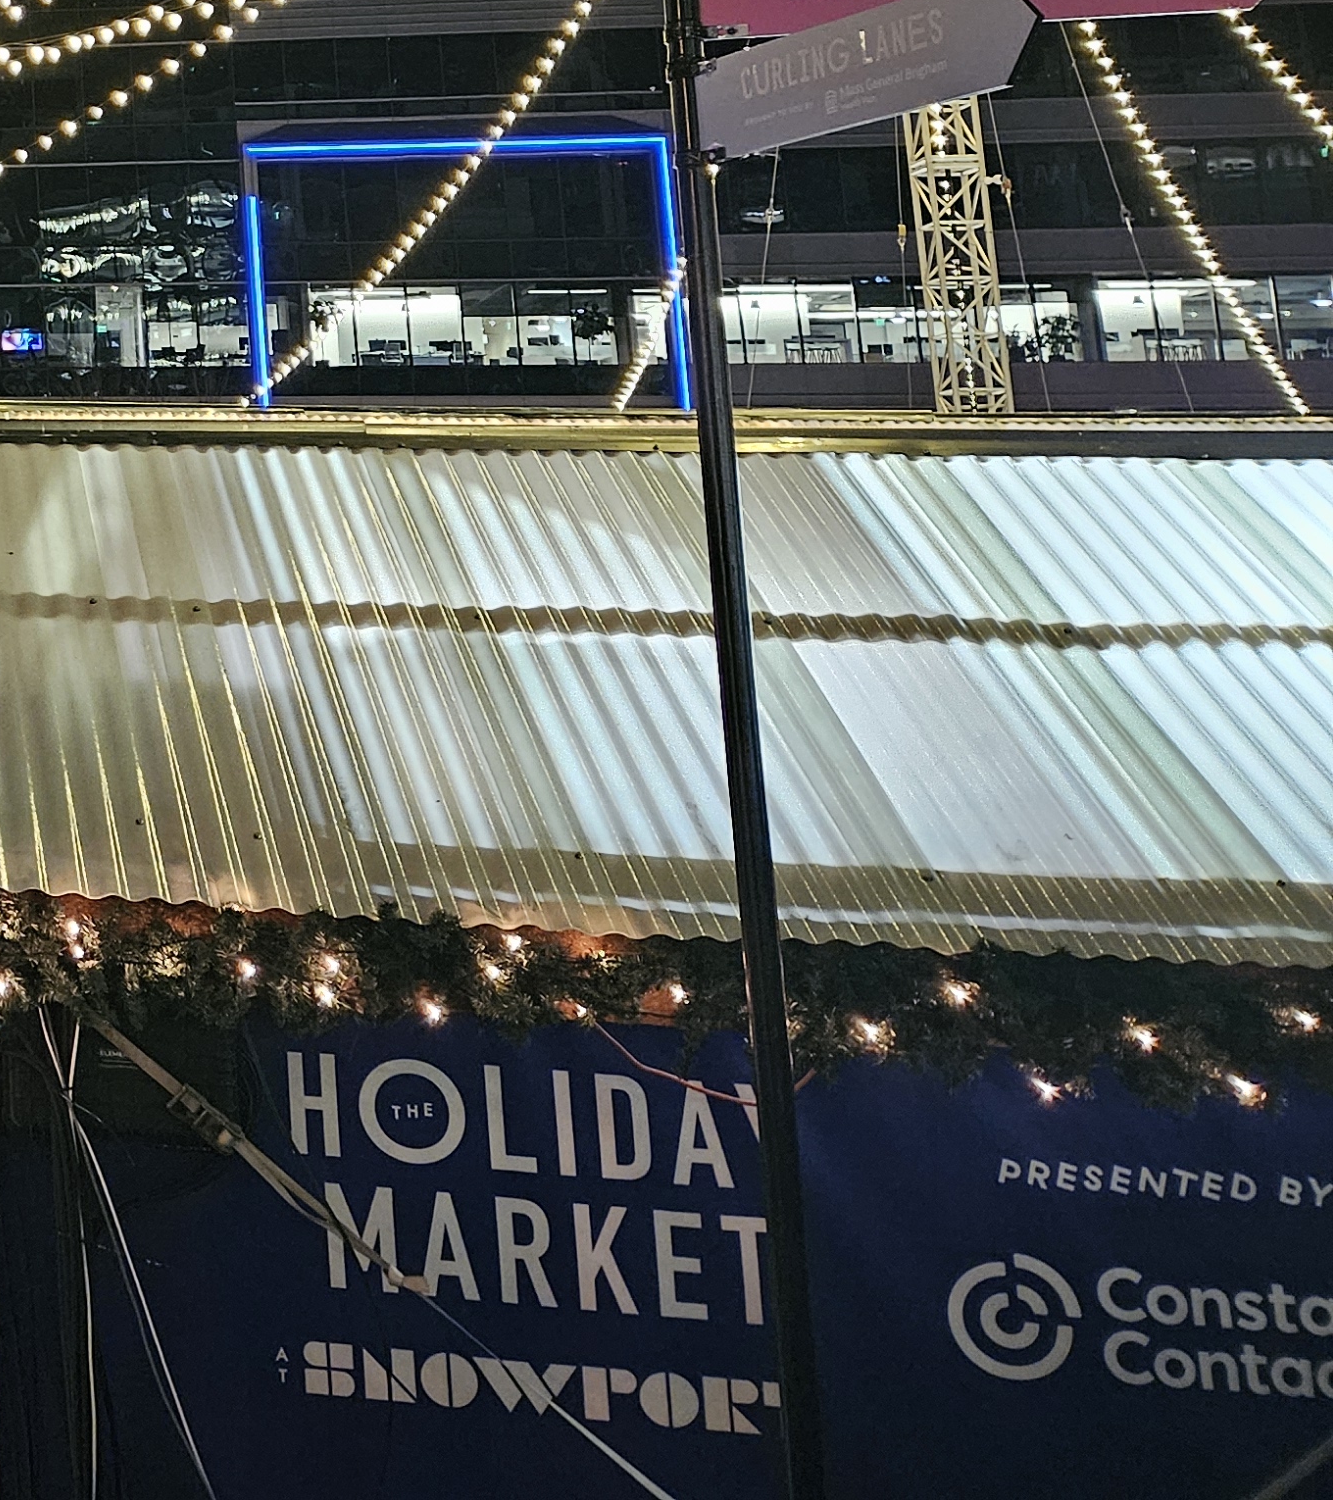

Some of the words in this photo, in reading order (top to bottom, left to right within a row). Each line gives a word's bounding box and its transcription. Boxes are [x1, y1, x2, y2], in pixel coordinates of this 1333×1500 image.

[740, 38, 850, 99] CURLING
[859, 7, 944, 64] LANES
[866, 69, 903, 91] General
[391, 1102, 434, 1120] THE
[997, 1158, 1258, 1202] PRESENTED
[1279, 1175, 1333, 1207] BY
[324, 1182, 768, 1326] MARKET
[303, 1341, 781, 1436] SNOWPOR
